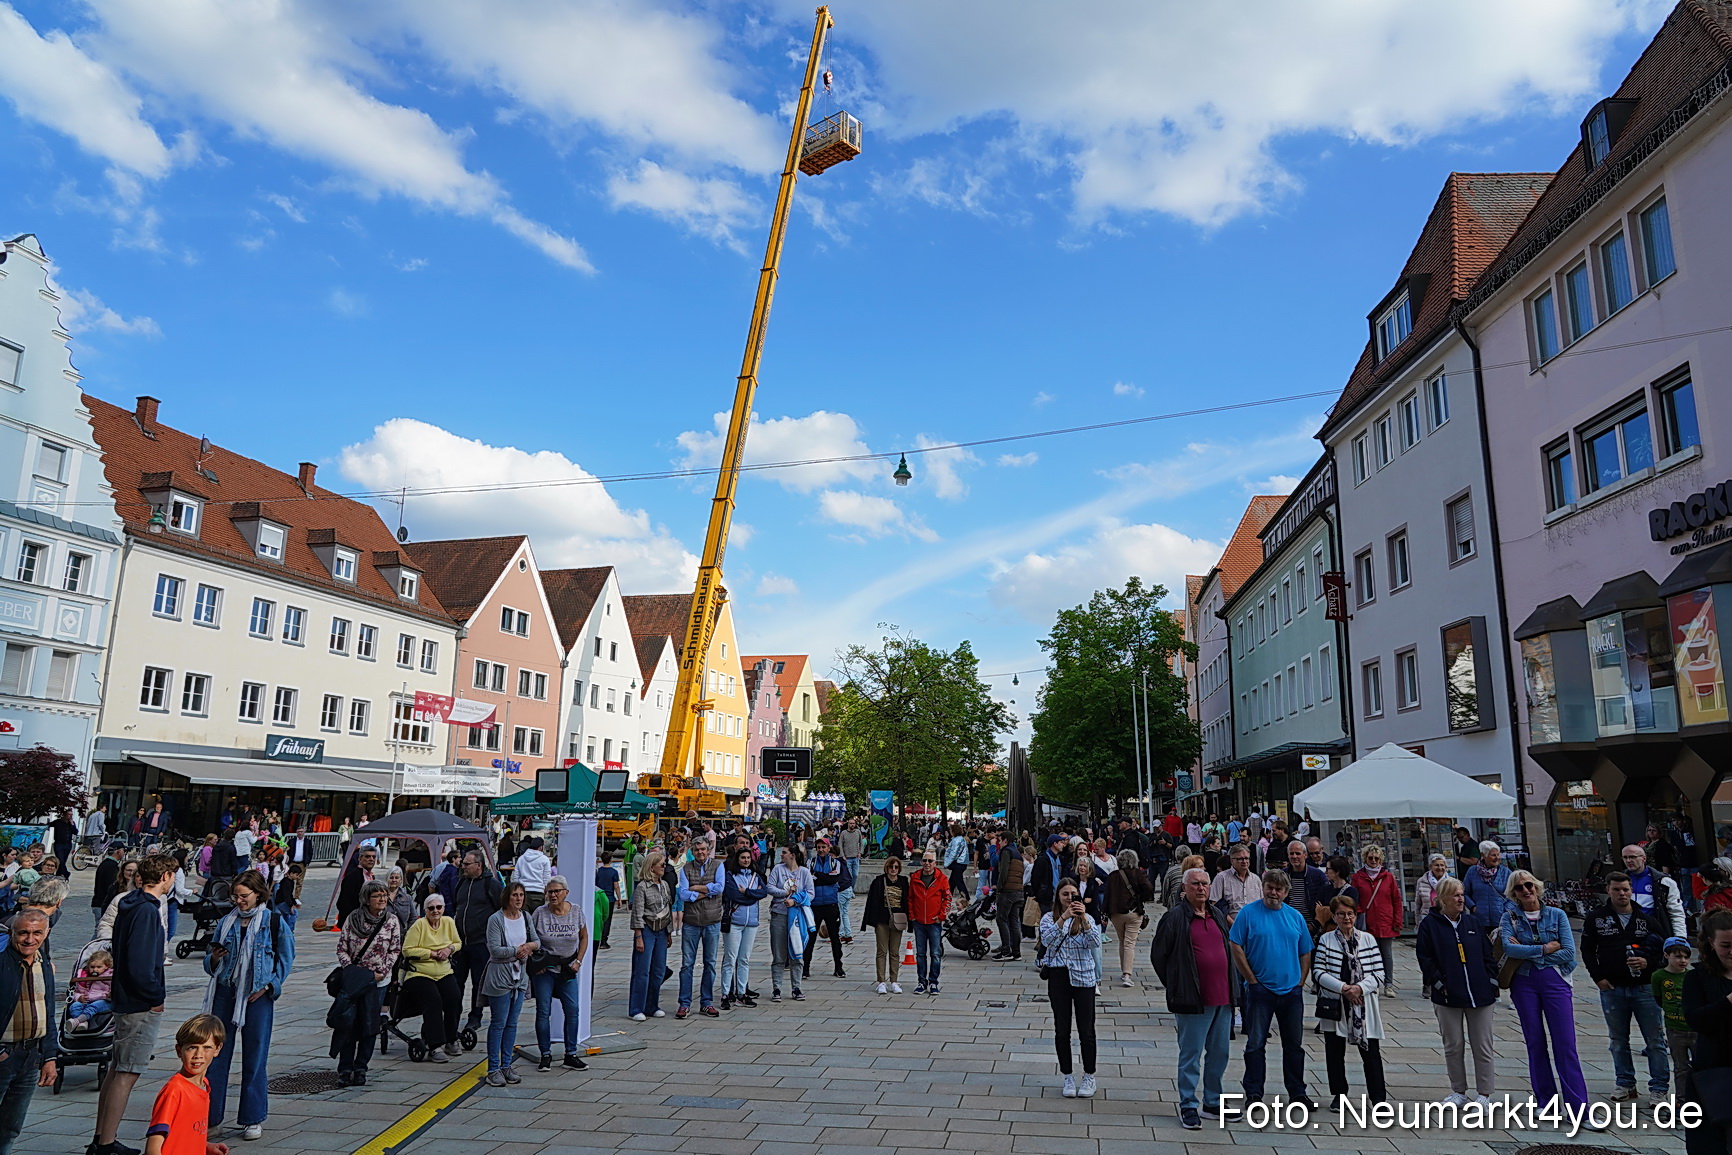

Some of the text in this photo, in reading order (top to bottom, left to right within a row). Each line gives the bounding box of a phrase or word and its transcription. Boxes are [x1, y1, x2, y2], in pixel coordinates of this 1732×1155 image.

[1670, 542, 1691, 556] am
[1327, 582, 1339, 617] Achatz
[683, 571, 711, 670] Schmidbauer
[574, 801, 591, 809] AOK
[546, 923, 576, 932] AMAZING
